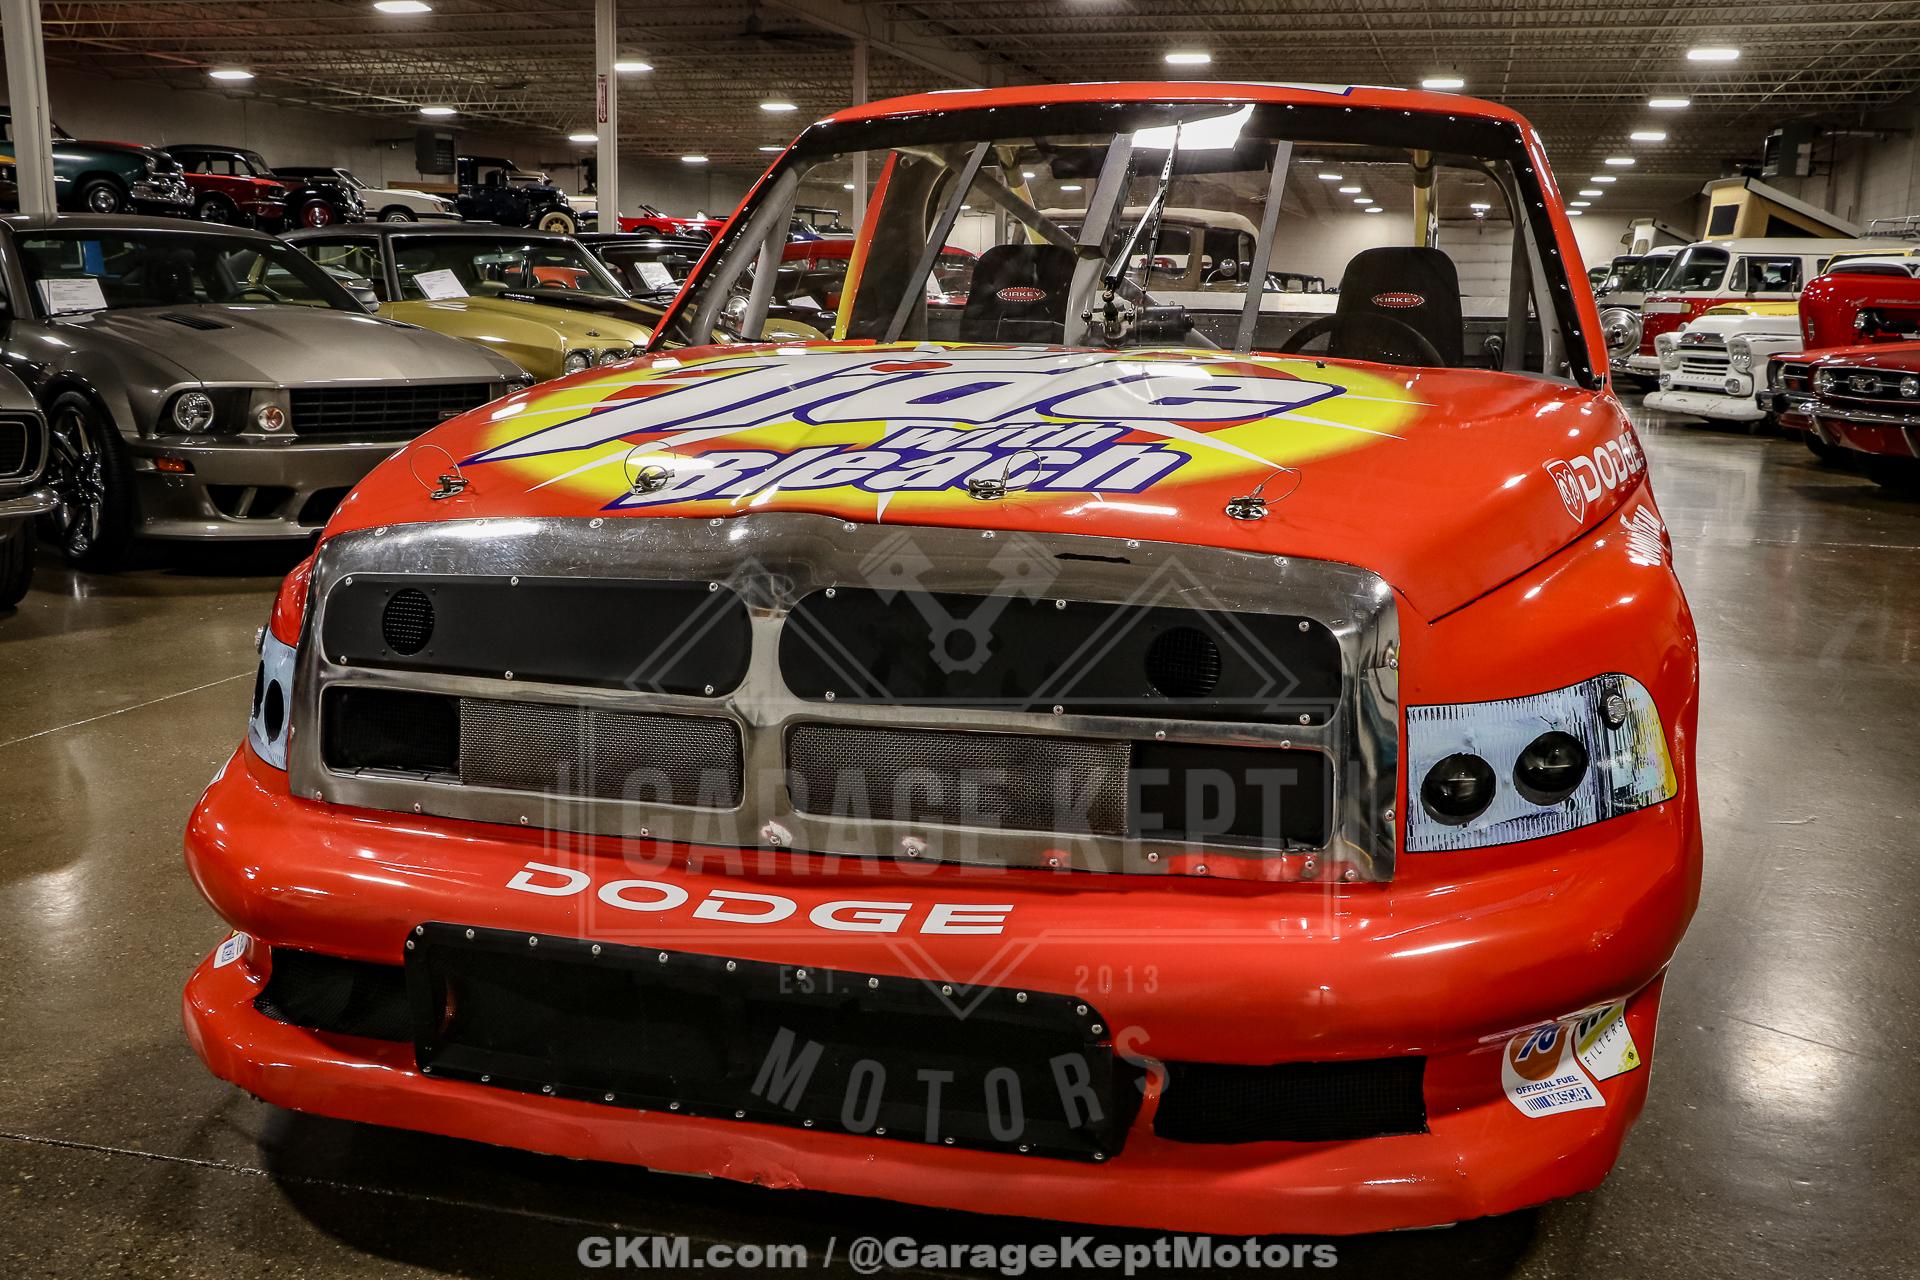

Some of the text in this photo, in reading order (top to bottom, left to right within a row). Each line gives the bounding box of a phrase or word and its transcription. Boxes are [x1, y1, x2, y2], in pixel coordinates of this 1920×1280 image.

[460, 352, 1347, 466] Tide
[876, 423, 1128, 453] with
[602, 443, 1190, 511] Bleach
[1569, 430, 1643, 503] DODGE
[506, 861, 1015, 936] DODGE
[1584, 1016, 1624, 1066] FILTERS
[1515, 1074, 1579, 1095] OFFICIAL FUEL
[1546, 1086, 1592, 1107] NASCAR
